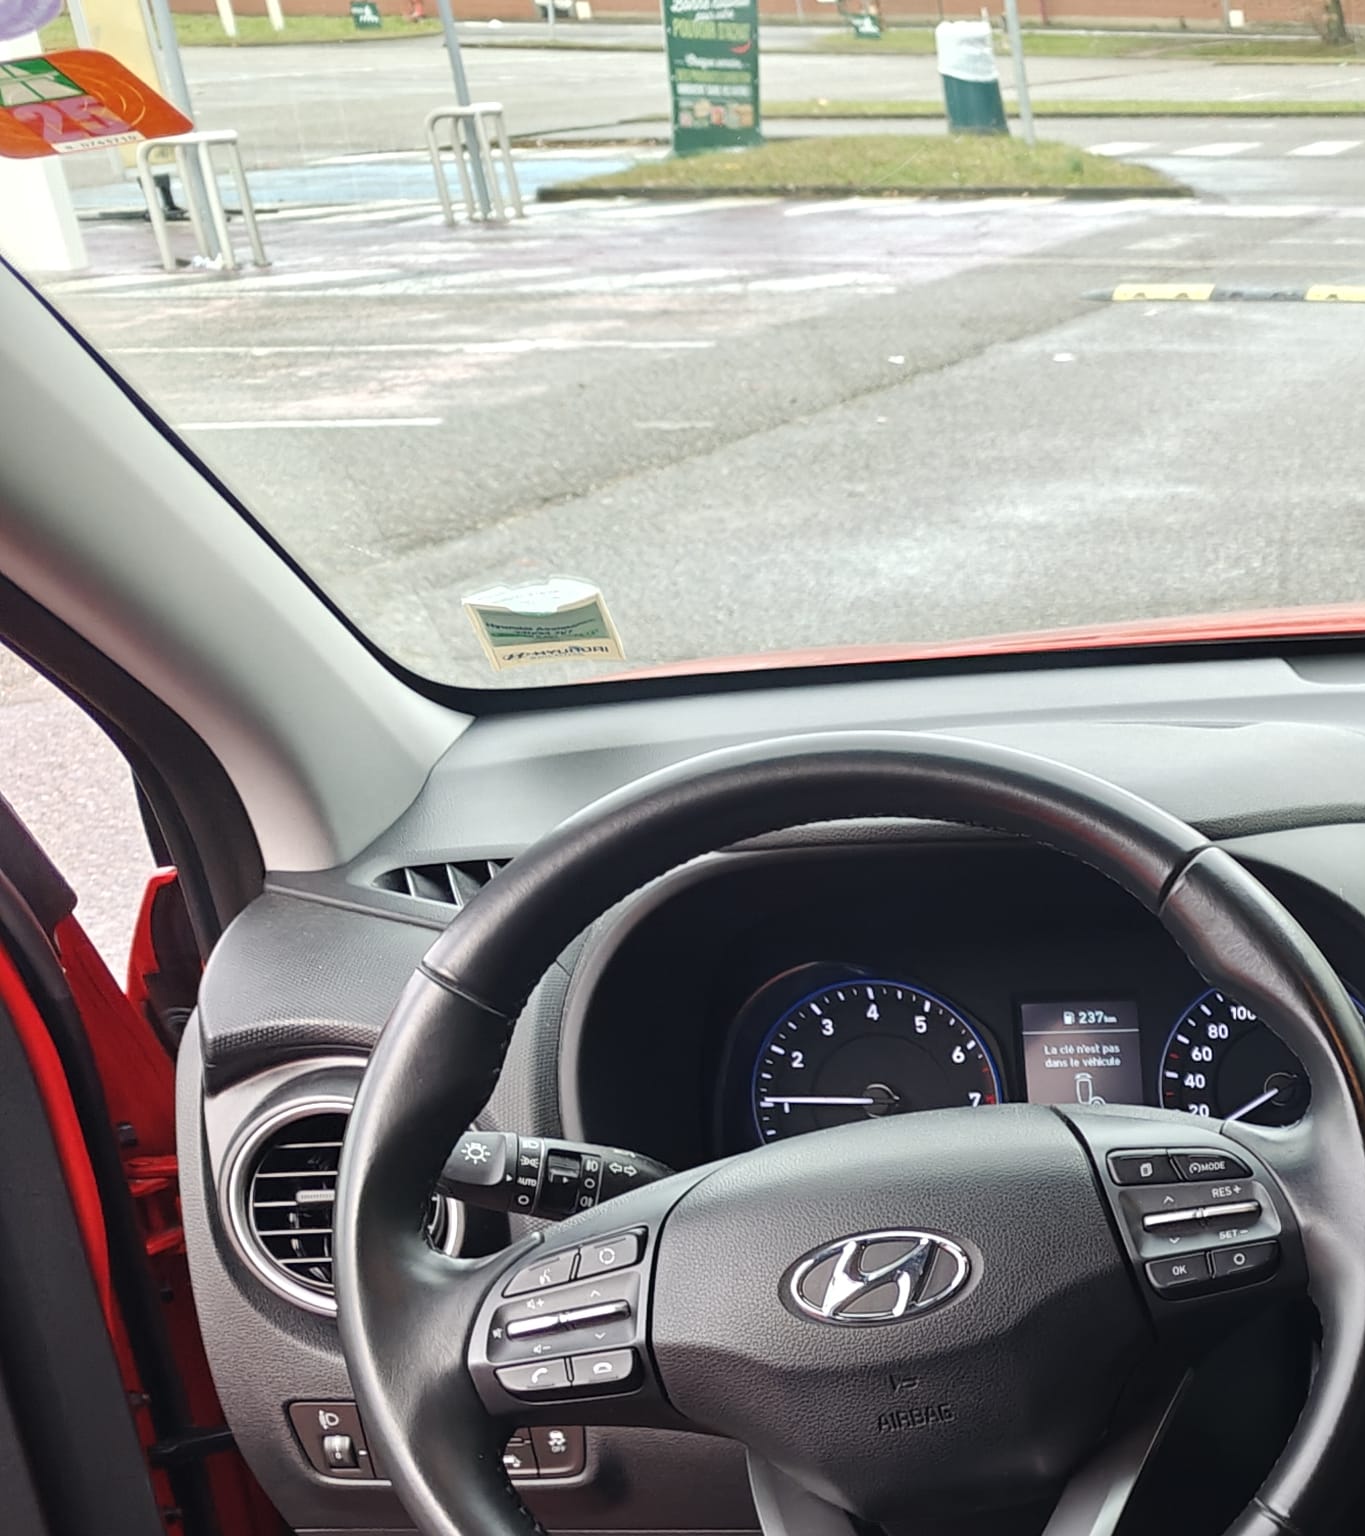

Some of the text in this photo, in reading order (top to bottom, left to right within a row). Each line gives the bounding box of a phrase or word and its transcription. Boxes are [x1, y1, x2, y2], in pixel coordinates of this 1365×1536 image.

[866, 1003, 880, 1021] 4
[821, 1018, 835, 1036] 3
[914, 1015, 927, 1033] 5
[1207, 1023, 1229, 1040] 80
[951, 1046, 966, 1064] 6
[1043, 1043, 1121, 1056] La clé n'est pas
[1191, 1046, 1213, 1062] 60
[791, 1051, 805, 1068] 2
[1045, 1055, 1122, 1069] dans le véhicule
[1184, 1074, 1206, 1089] 40
[968, 1092, 982, 1108] 7
[1188, 1104, 1210, 1118] 20
[1200, 1161, 1226, 1172] MODE
[517, 1176, 537, 1187] AUTO
[1172, 1265, 1187, 1276] OK
[878, 1403, 956, 1433] AIRBAG
